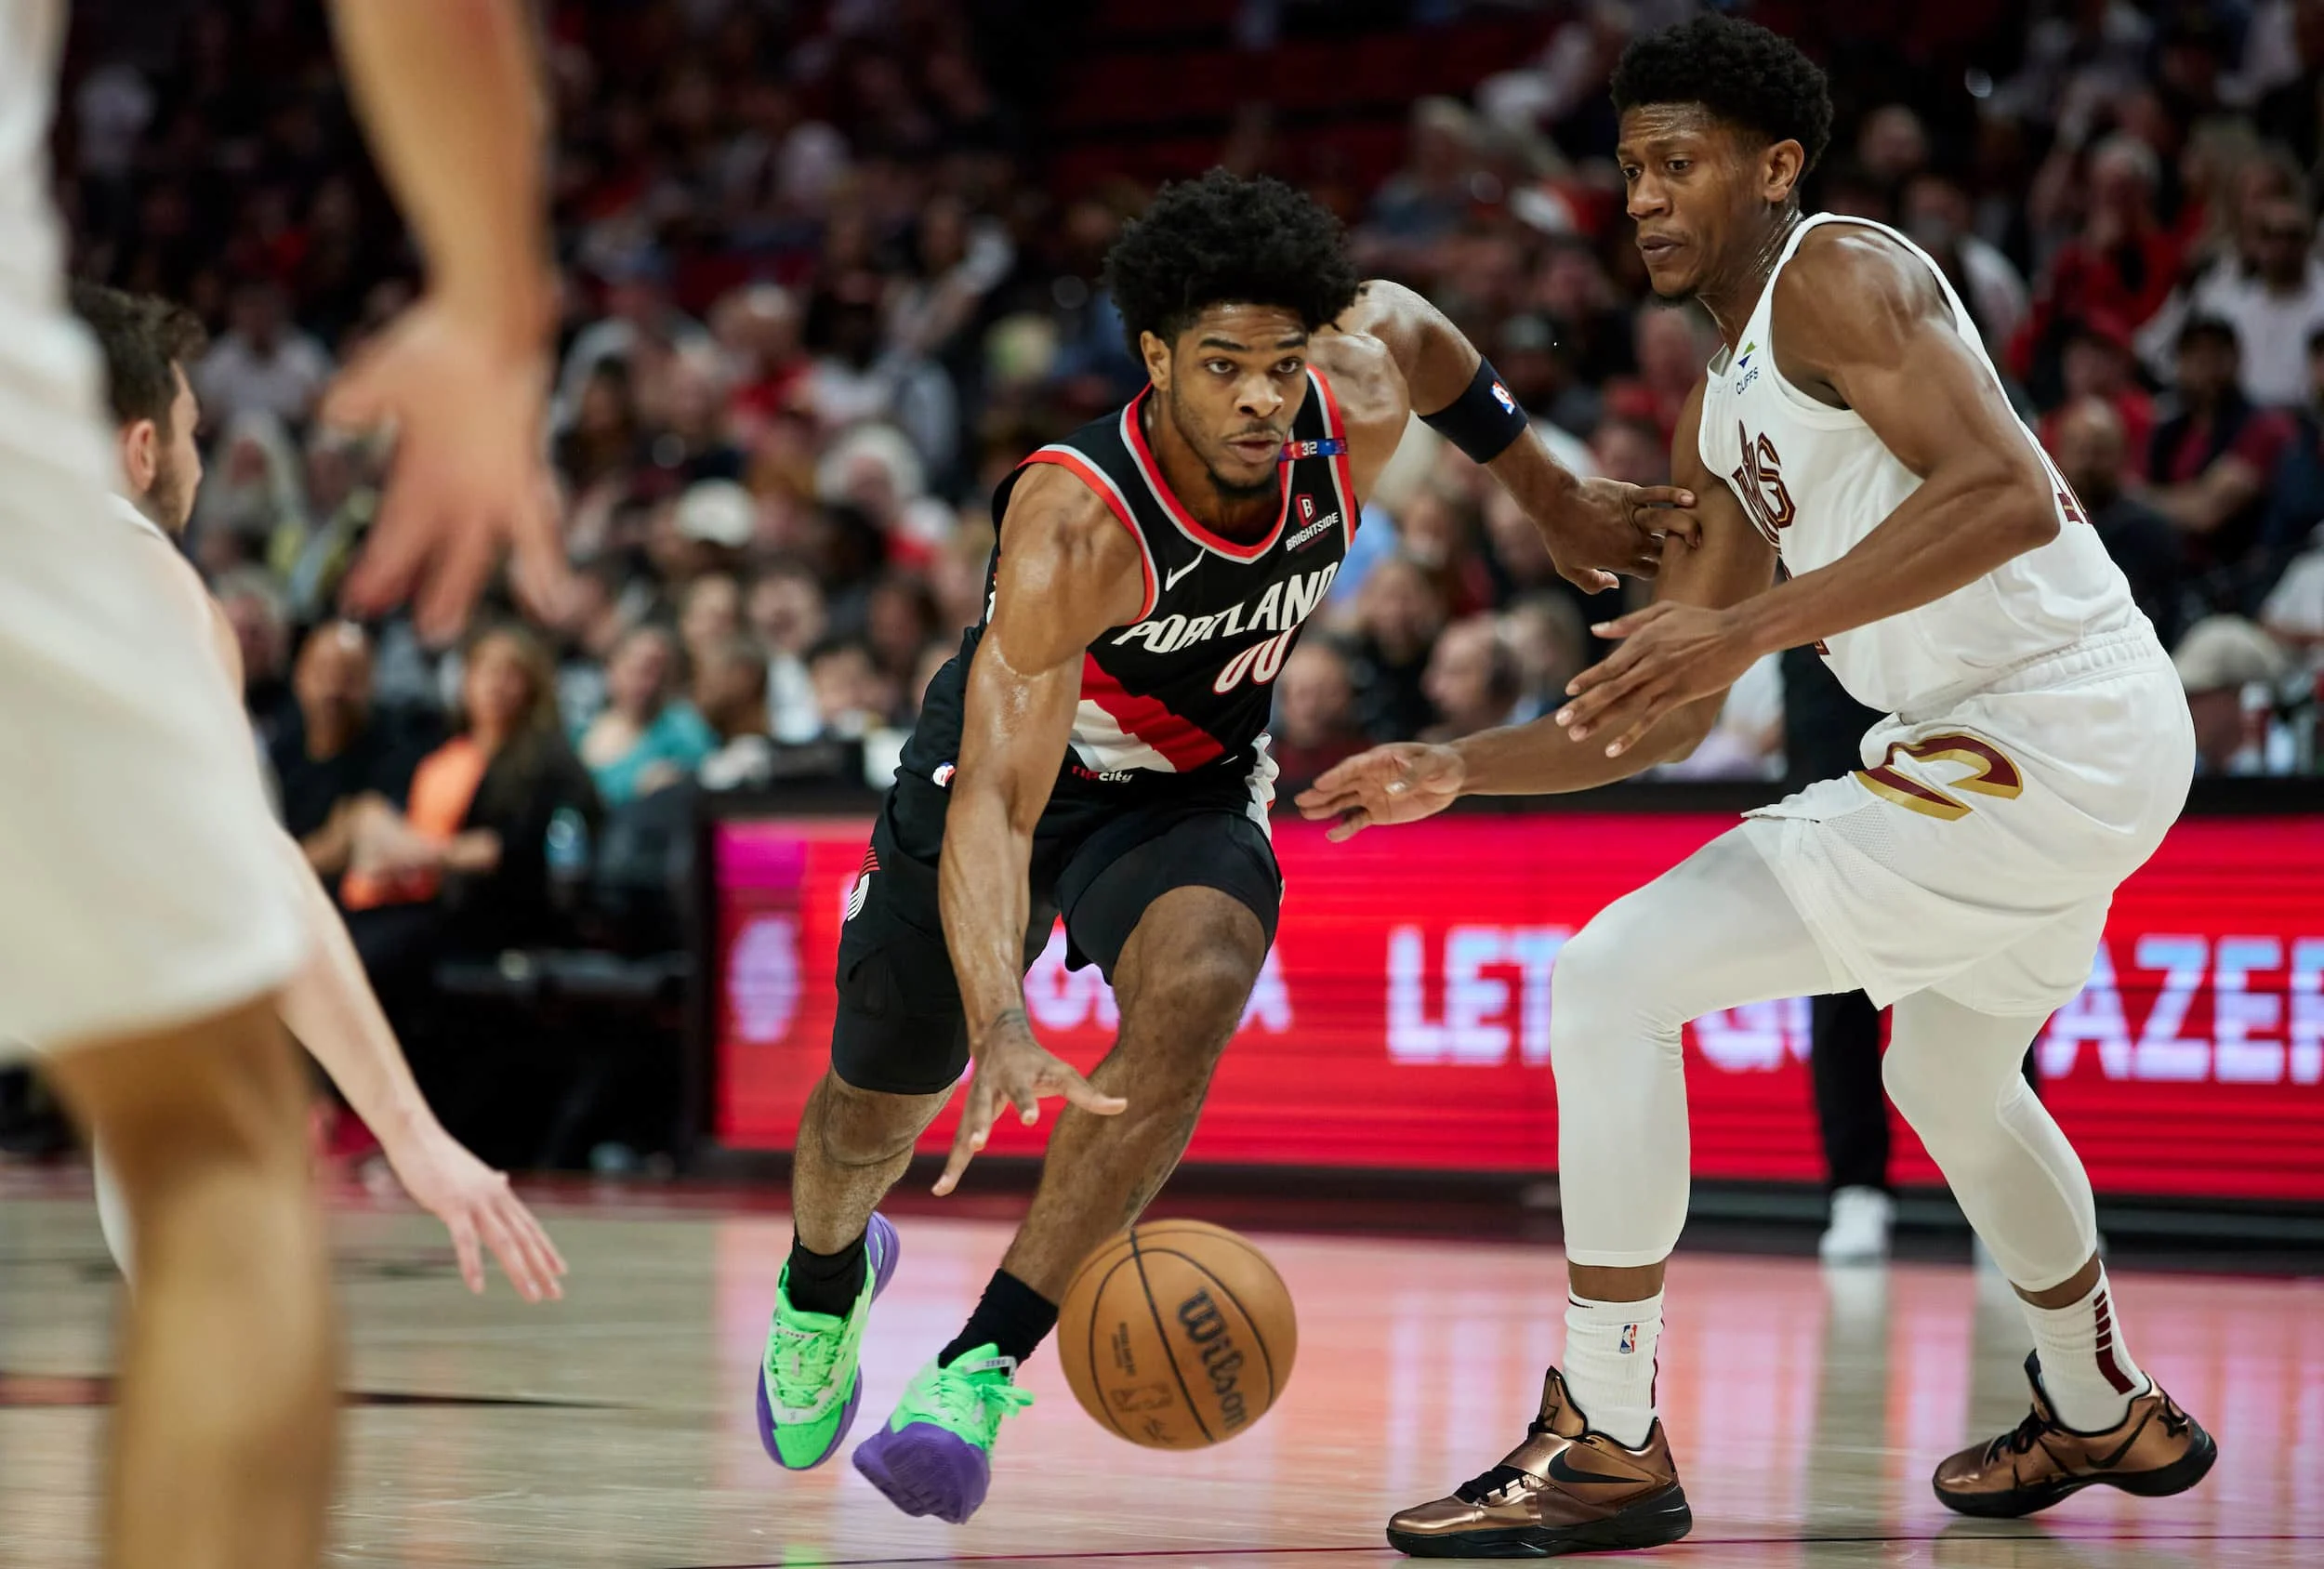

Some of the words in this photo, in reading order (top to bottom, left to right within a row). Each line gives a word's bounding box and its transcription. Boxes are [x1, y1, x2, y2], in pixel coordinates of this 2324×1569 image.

[1736, 366, 1759, 395] CLIFFS
[1301, 442, 1317, 455] 32
[1301, 499, 1313, 518] B
[1286, 512, 1339, 551] BRIGHTSIDE
[1111, 561, 1339, 653] PORTLAND
[1213, 624, 1298, 695] 00
[1178, 1286, 1248, 1430] Wilson
